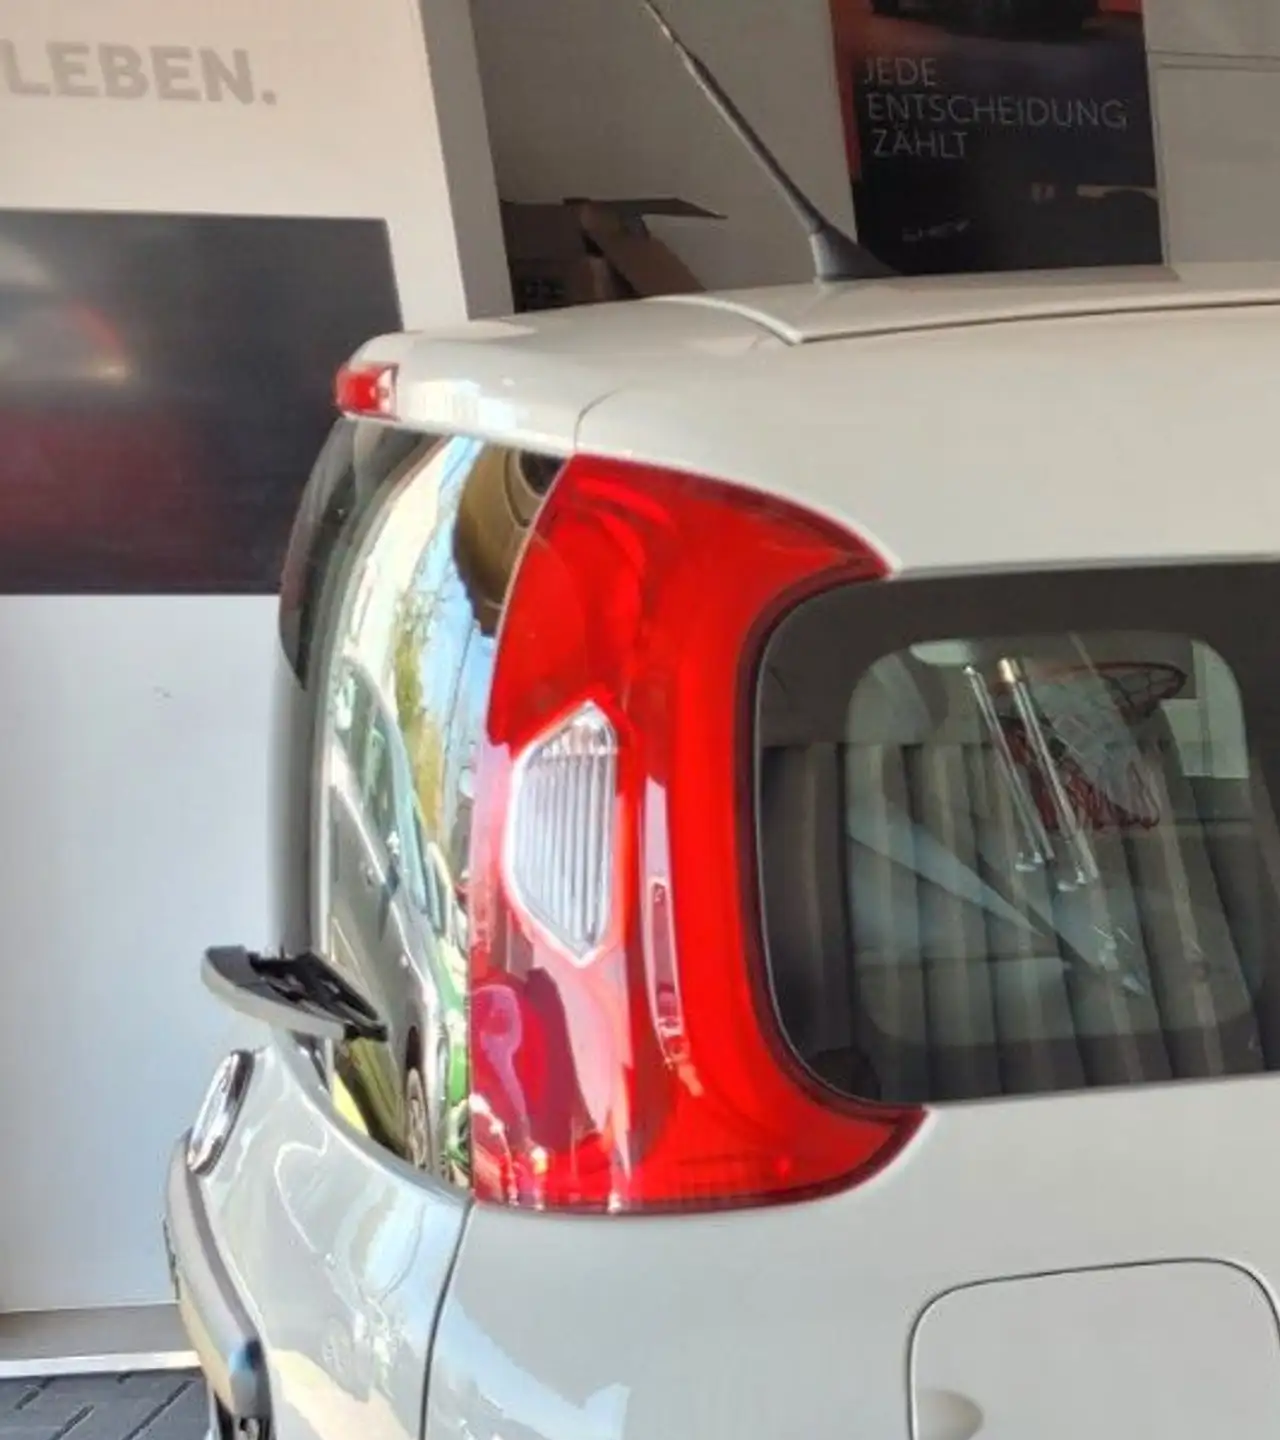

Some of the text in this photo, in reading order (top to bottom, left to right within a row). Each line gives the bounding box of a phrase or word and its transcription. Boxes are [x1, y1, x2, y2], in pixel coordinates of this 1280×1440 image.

[0, 38, 277, 106] LEBEN.
[864, 57, 937, 86] JEDE
[866, 93, 1128, 130] ENTSCHEIDUNG
[872, 124, 968, 158] ZÄHLT
